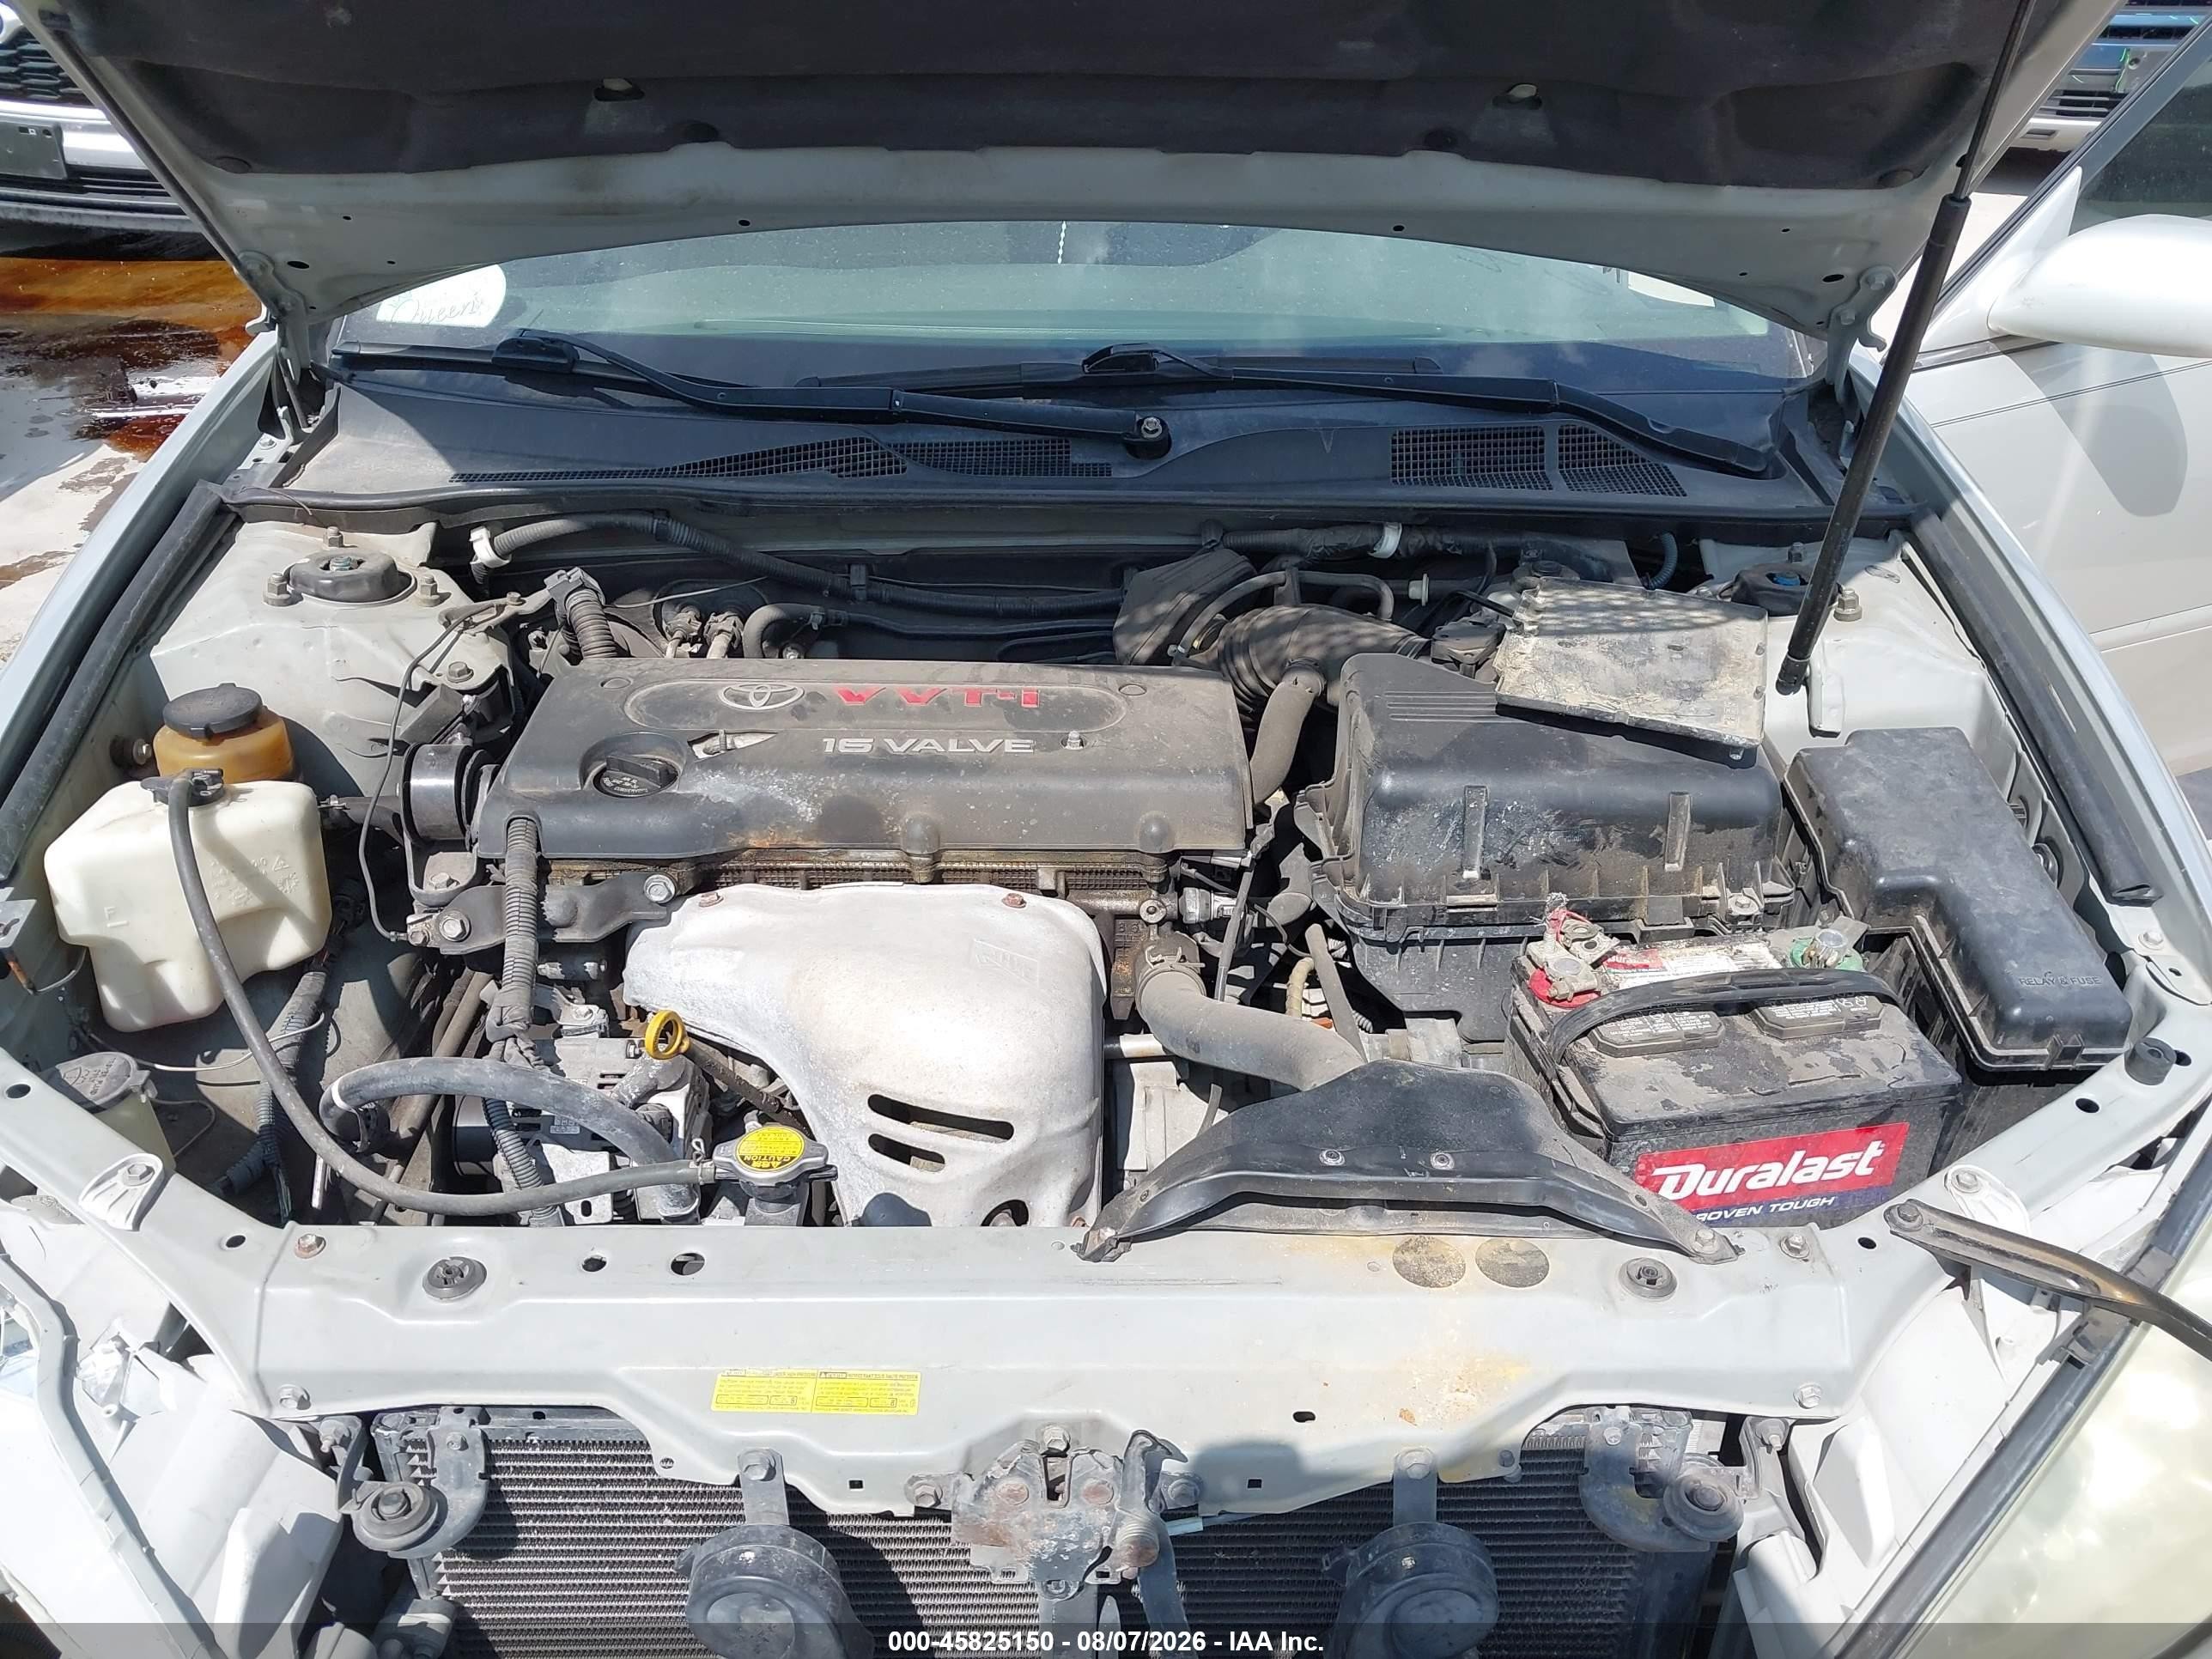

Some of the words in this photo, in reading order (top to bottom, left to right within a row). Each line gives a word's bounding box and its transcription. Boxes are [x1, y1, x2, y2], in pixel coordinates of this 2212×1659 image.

[823, 737, 874, 754] 16
[883, 737, 1036, 754] VALVE
[2019, 976, 2056, 987] RELAY
[2070, 975, 2103, 986] FUSE
[1652, 1140, 1884, 1200] Duralast
[1692, 1205, 1763, 1223] ROVEN
[1769, 1195, 1837, 1213] TOUGH
